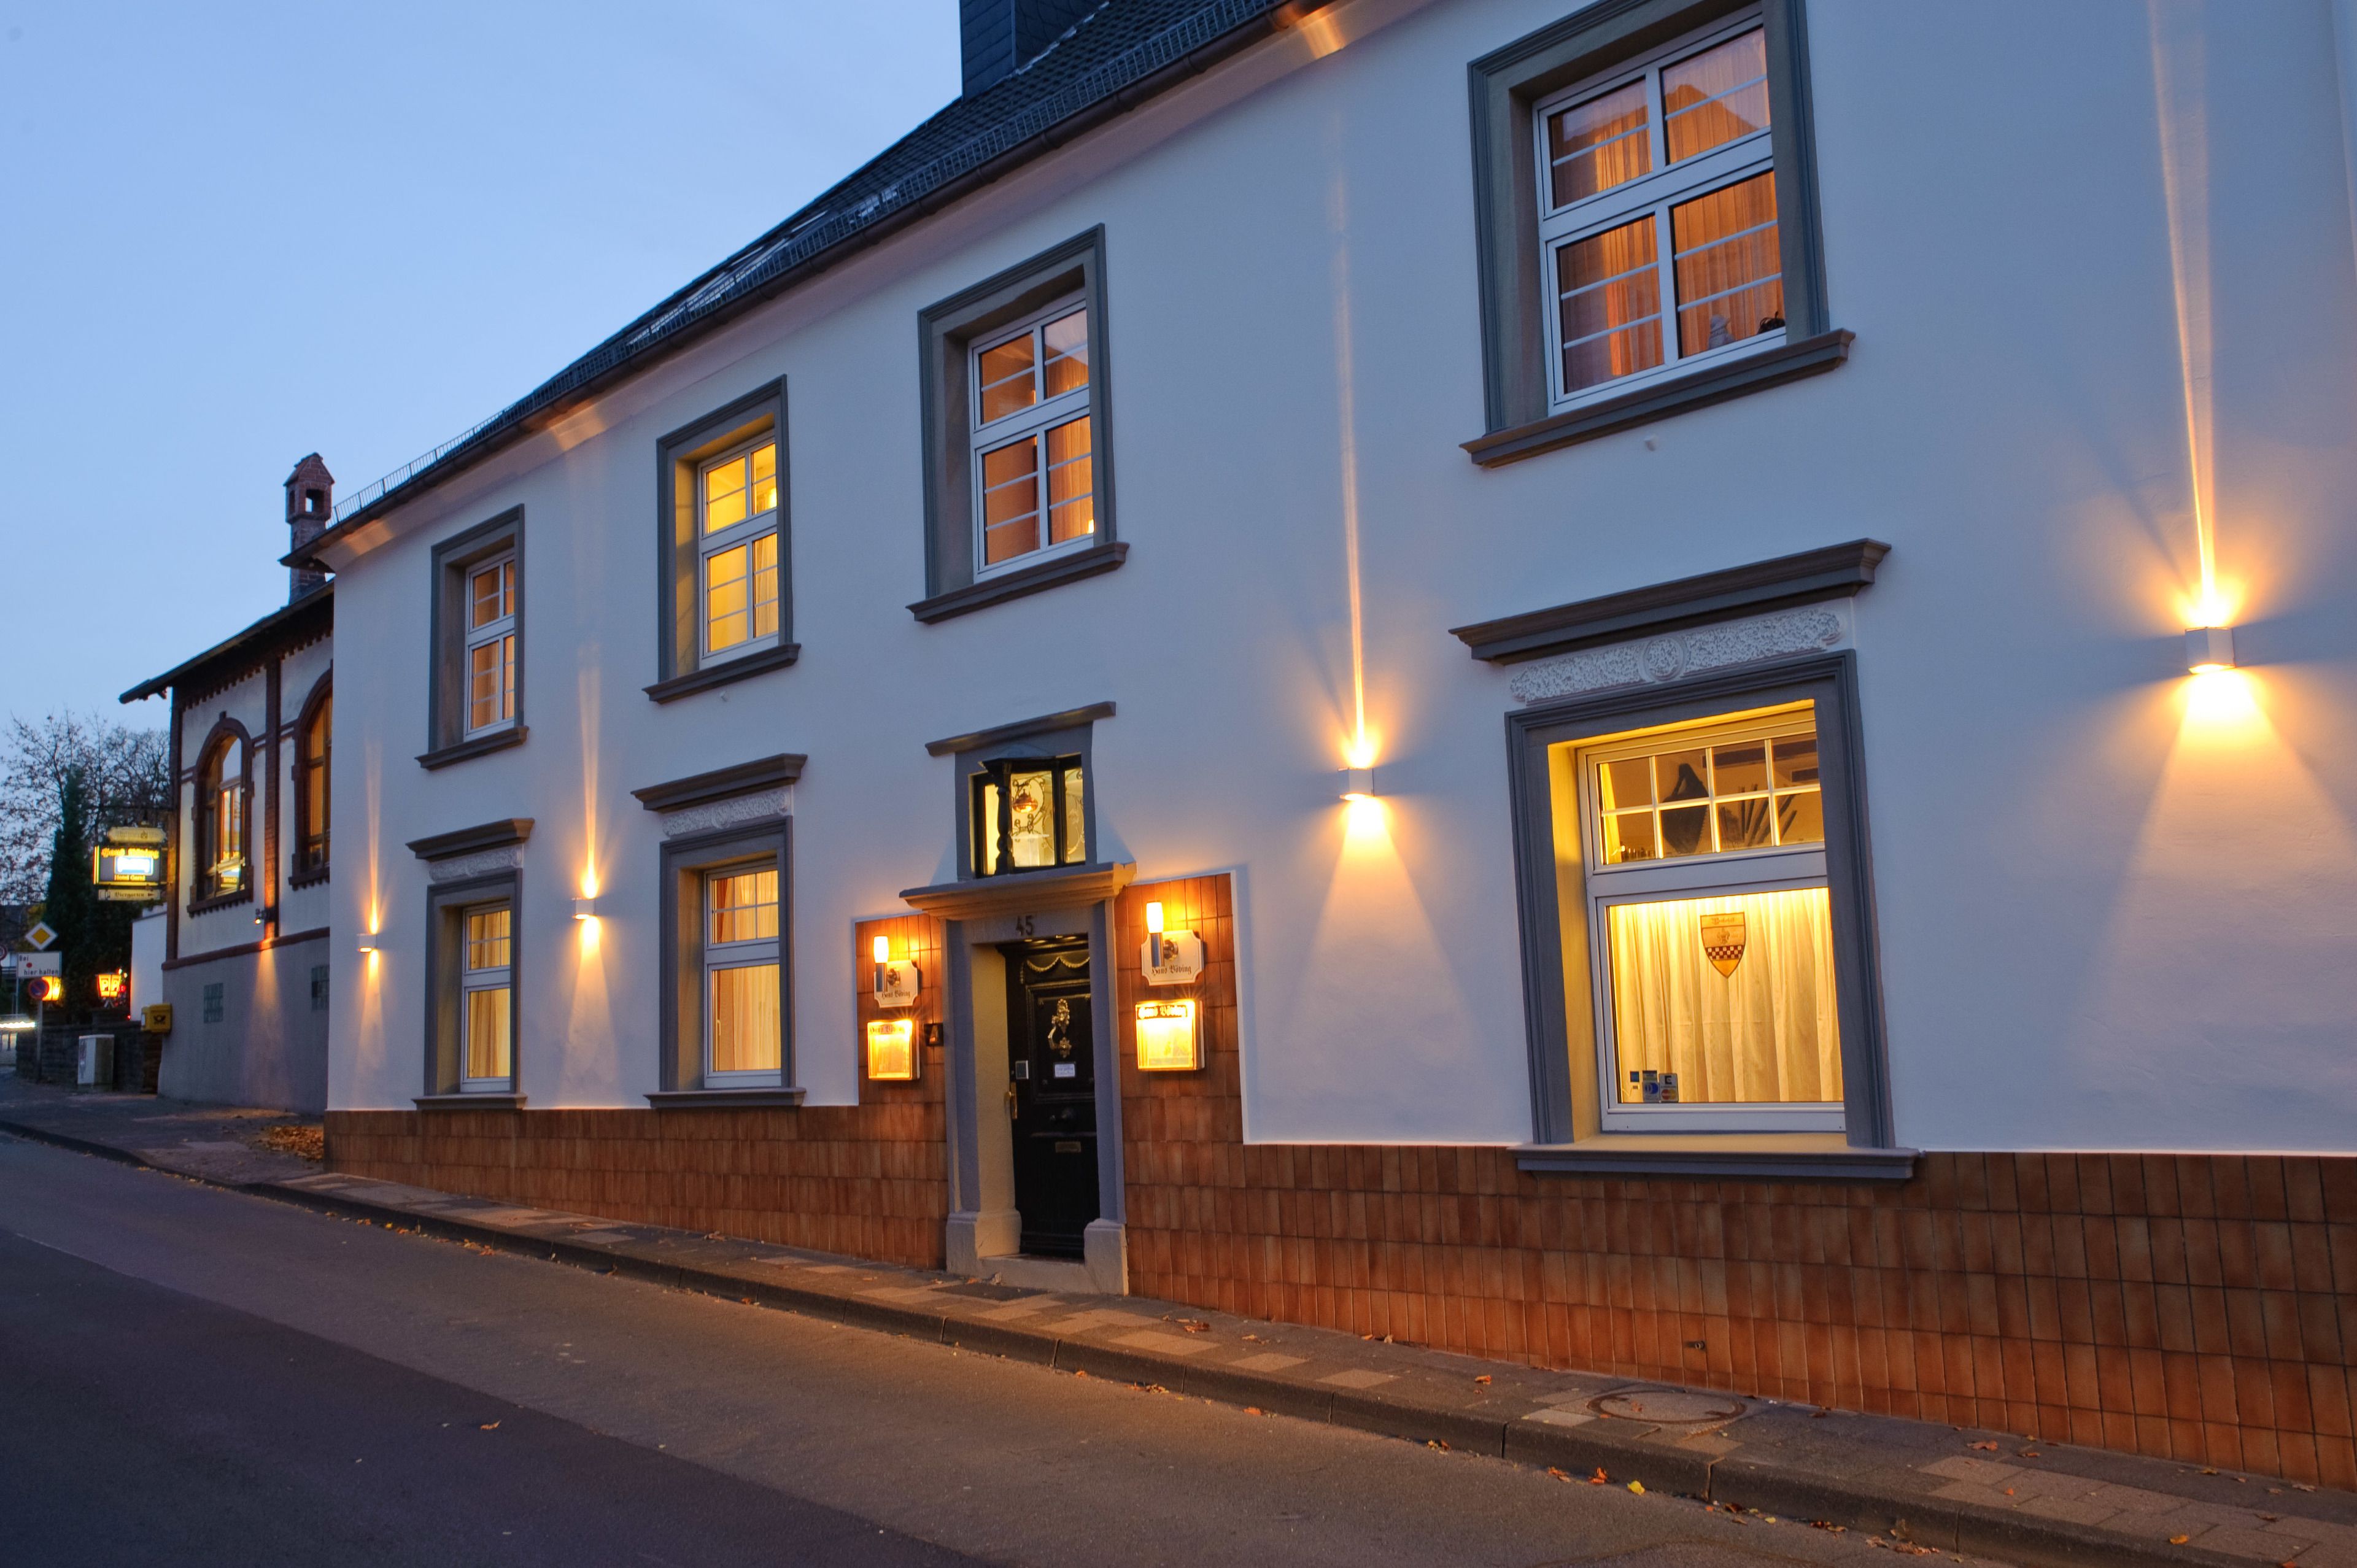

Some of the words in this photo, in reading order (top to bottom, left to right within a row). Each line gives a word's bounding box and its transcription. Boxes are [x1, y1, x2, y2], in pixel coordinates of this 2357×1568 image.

[1016, 915, 1034, 935] 45
[1151, 967, 1167, 976] Haus
[1169, 965, 1191, 975] Böving
[101, 979, 109, 991] P
